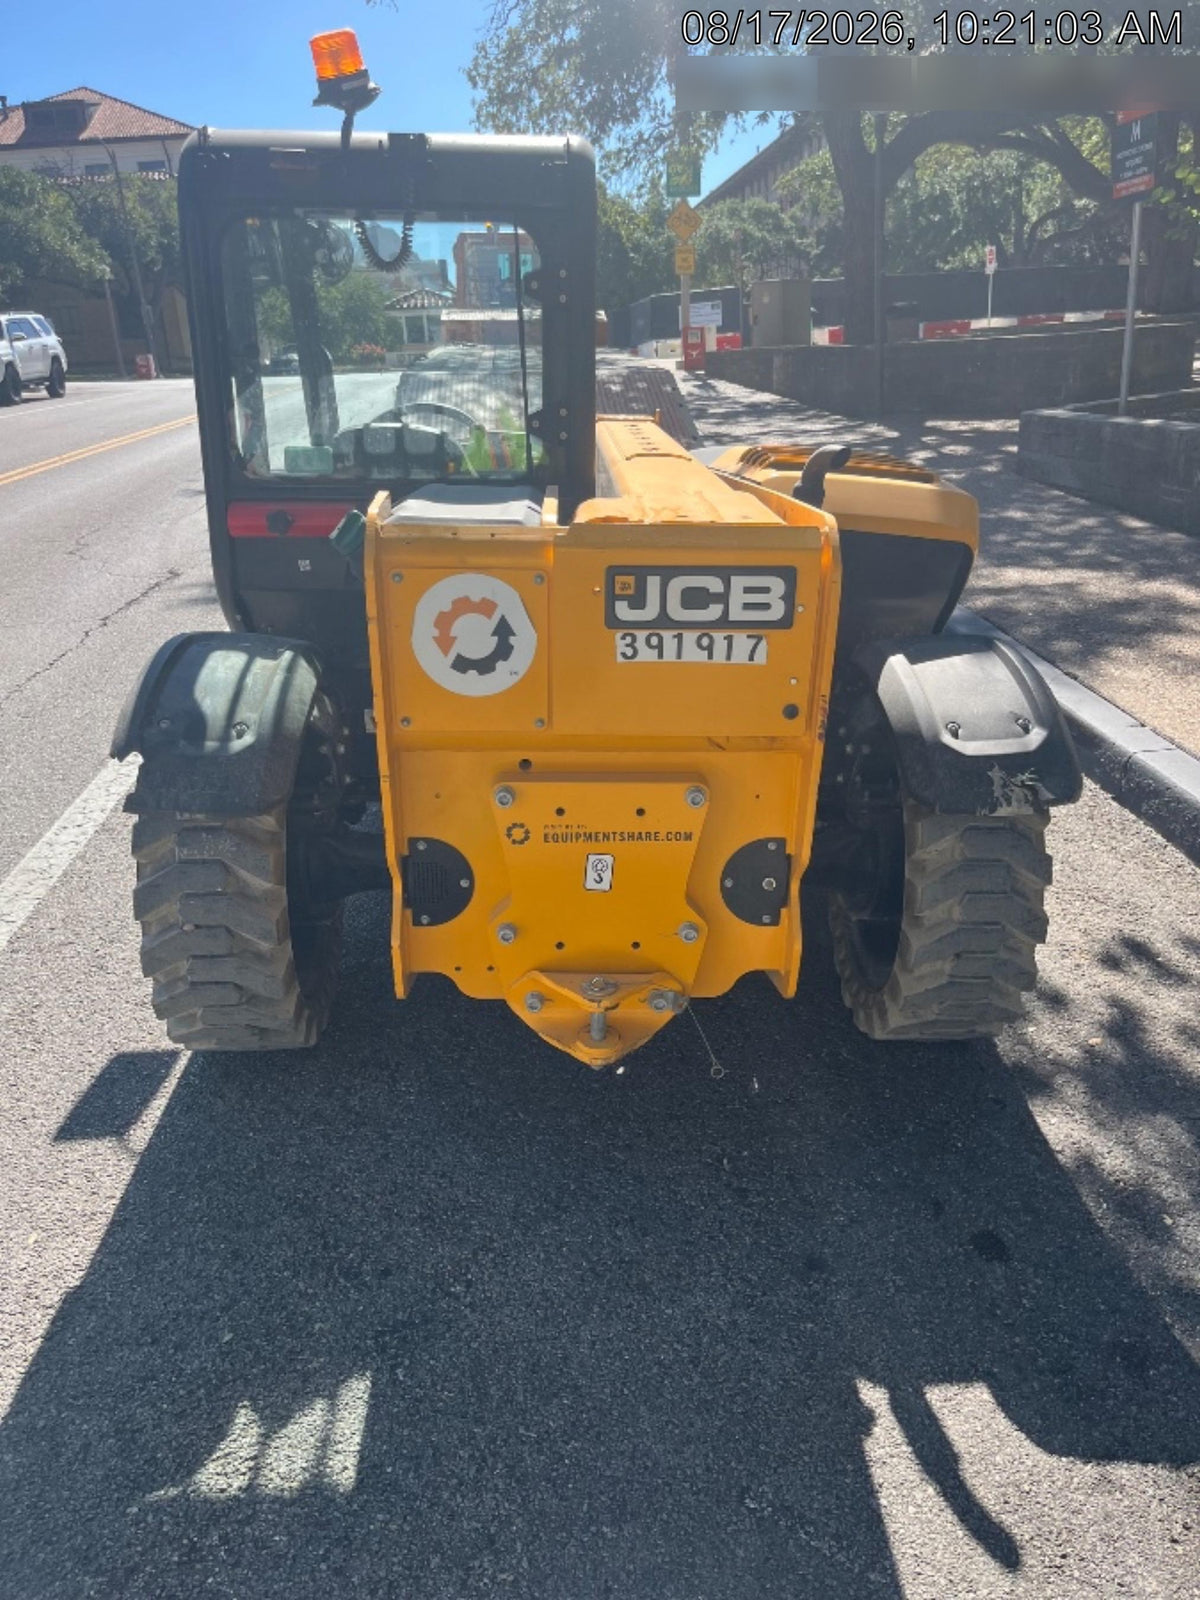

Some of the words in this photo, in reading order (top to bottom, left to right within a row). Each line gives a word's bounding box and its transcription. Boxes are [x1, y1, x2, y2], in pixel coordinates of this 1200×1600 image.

[614, 575, 786, 622] JCB
[619, 632, 764, 662] 391917
[543, 831, 693, 844] EQUIPMENTSHARE.COM
